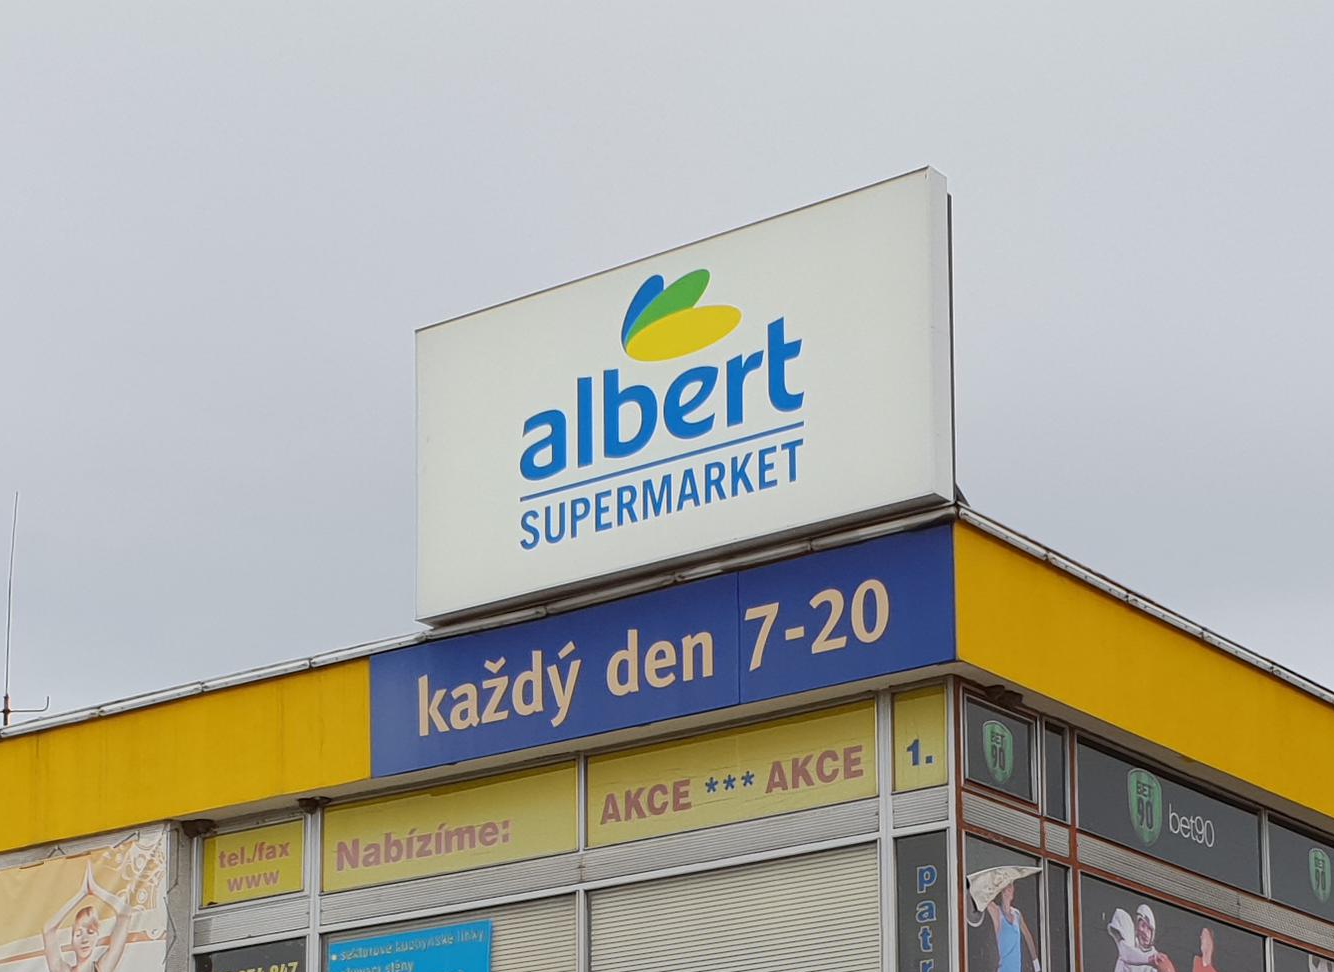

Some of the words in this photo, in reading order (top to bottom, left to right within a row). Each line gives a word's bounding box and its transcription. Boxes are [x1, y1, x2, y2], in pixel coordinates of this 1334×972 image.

[520, 316, 805, 481] albert
[520, 438, 804, 550] SUPERMARKET
[418, 641, 581, 737] každý
[606, 628, 714, 697] den
[744, 578, 889, 672] 7-20
[906, 738, 934, 768] 1.
[600, 779, 693, 826] AKCE
[765, 744, 864, 795] AKCE
[335, 818, 513, 873] Nabízíme:
[1168, 802, 1215, 848] bet90
[218, 840, 291, 870] tel./fax
[227, 870, 280, 893] www
